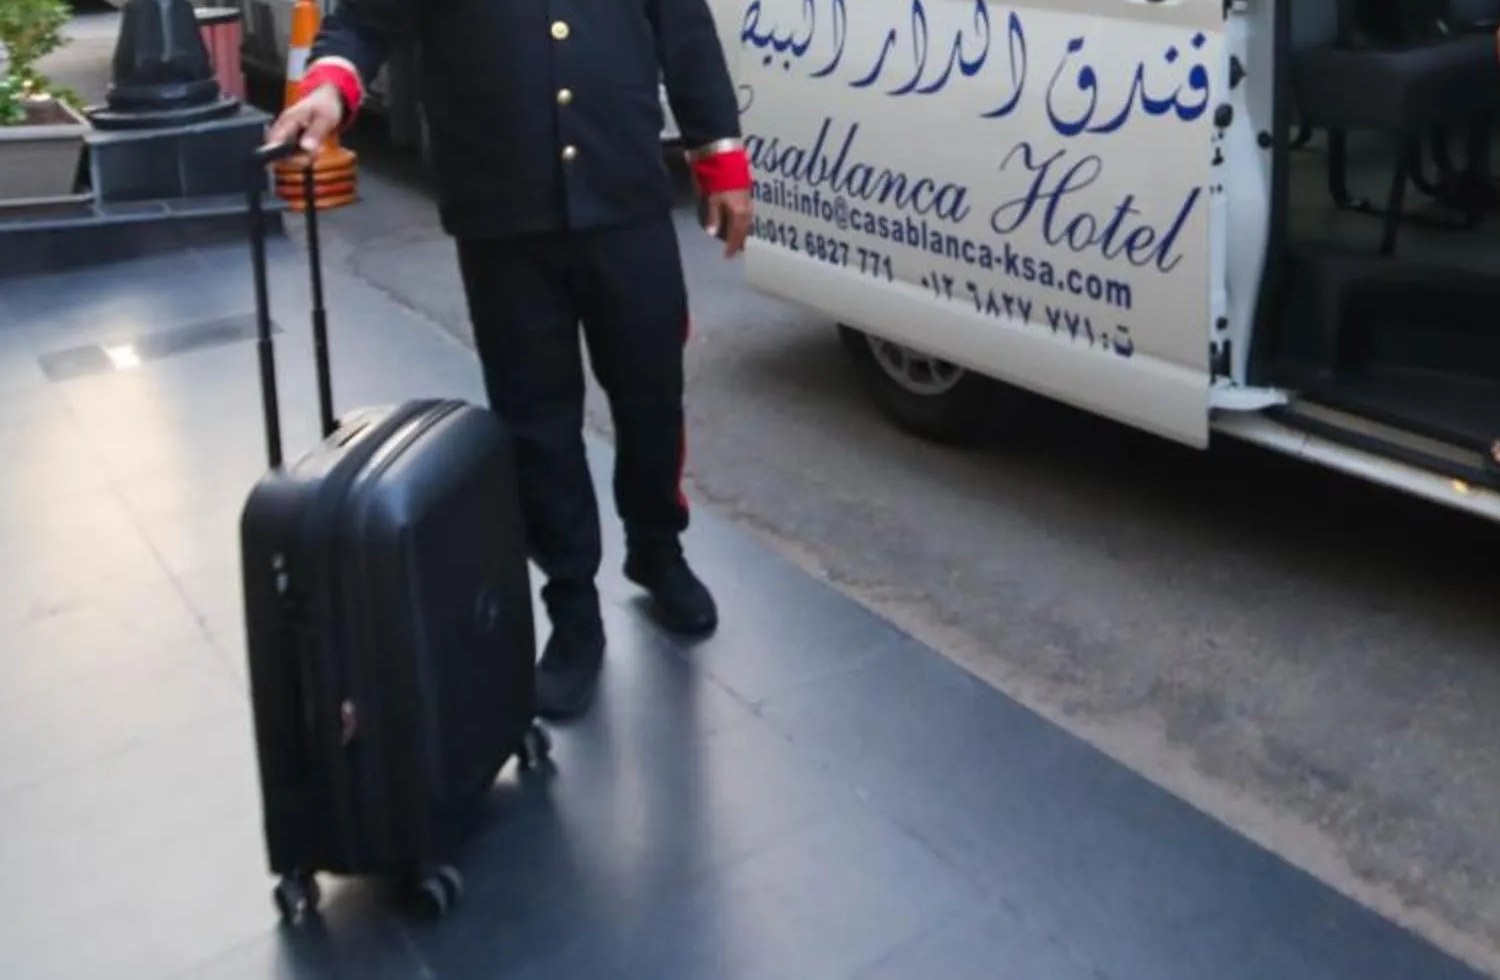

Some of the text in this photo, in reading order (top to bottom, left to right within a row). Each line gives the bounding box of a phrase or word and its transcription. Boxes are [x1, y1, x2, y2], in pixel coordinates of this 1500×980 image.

[1046, 32, 1210, 137] فندق
[738, 85, 1202, 274] asablanca Hotel
